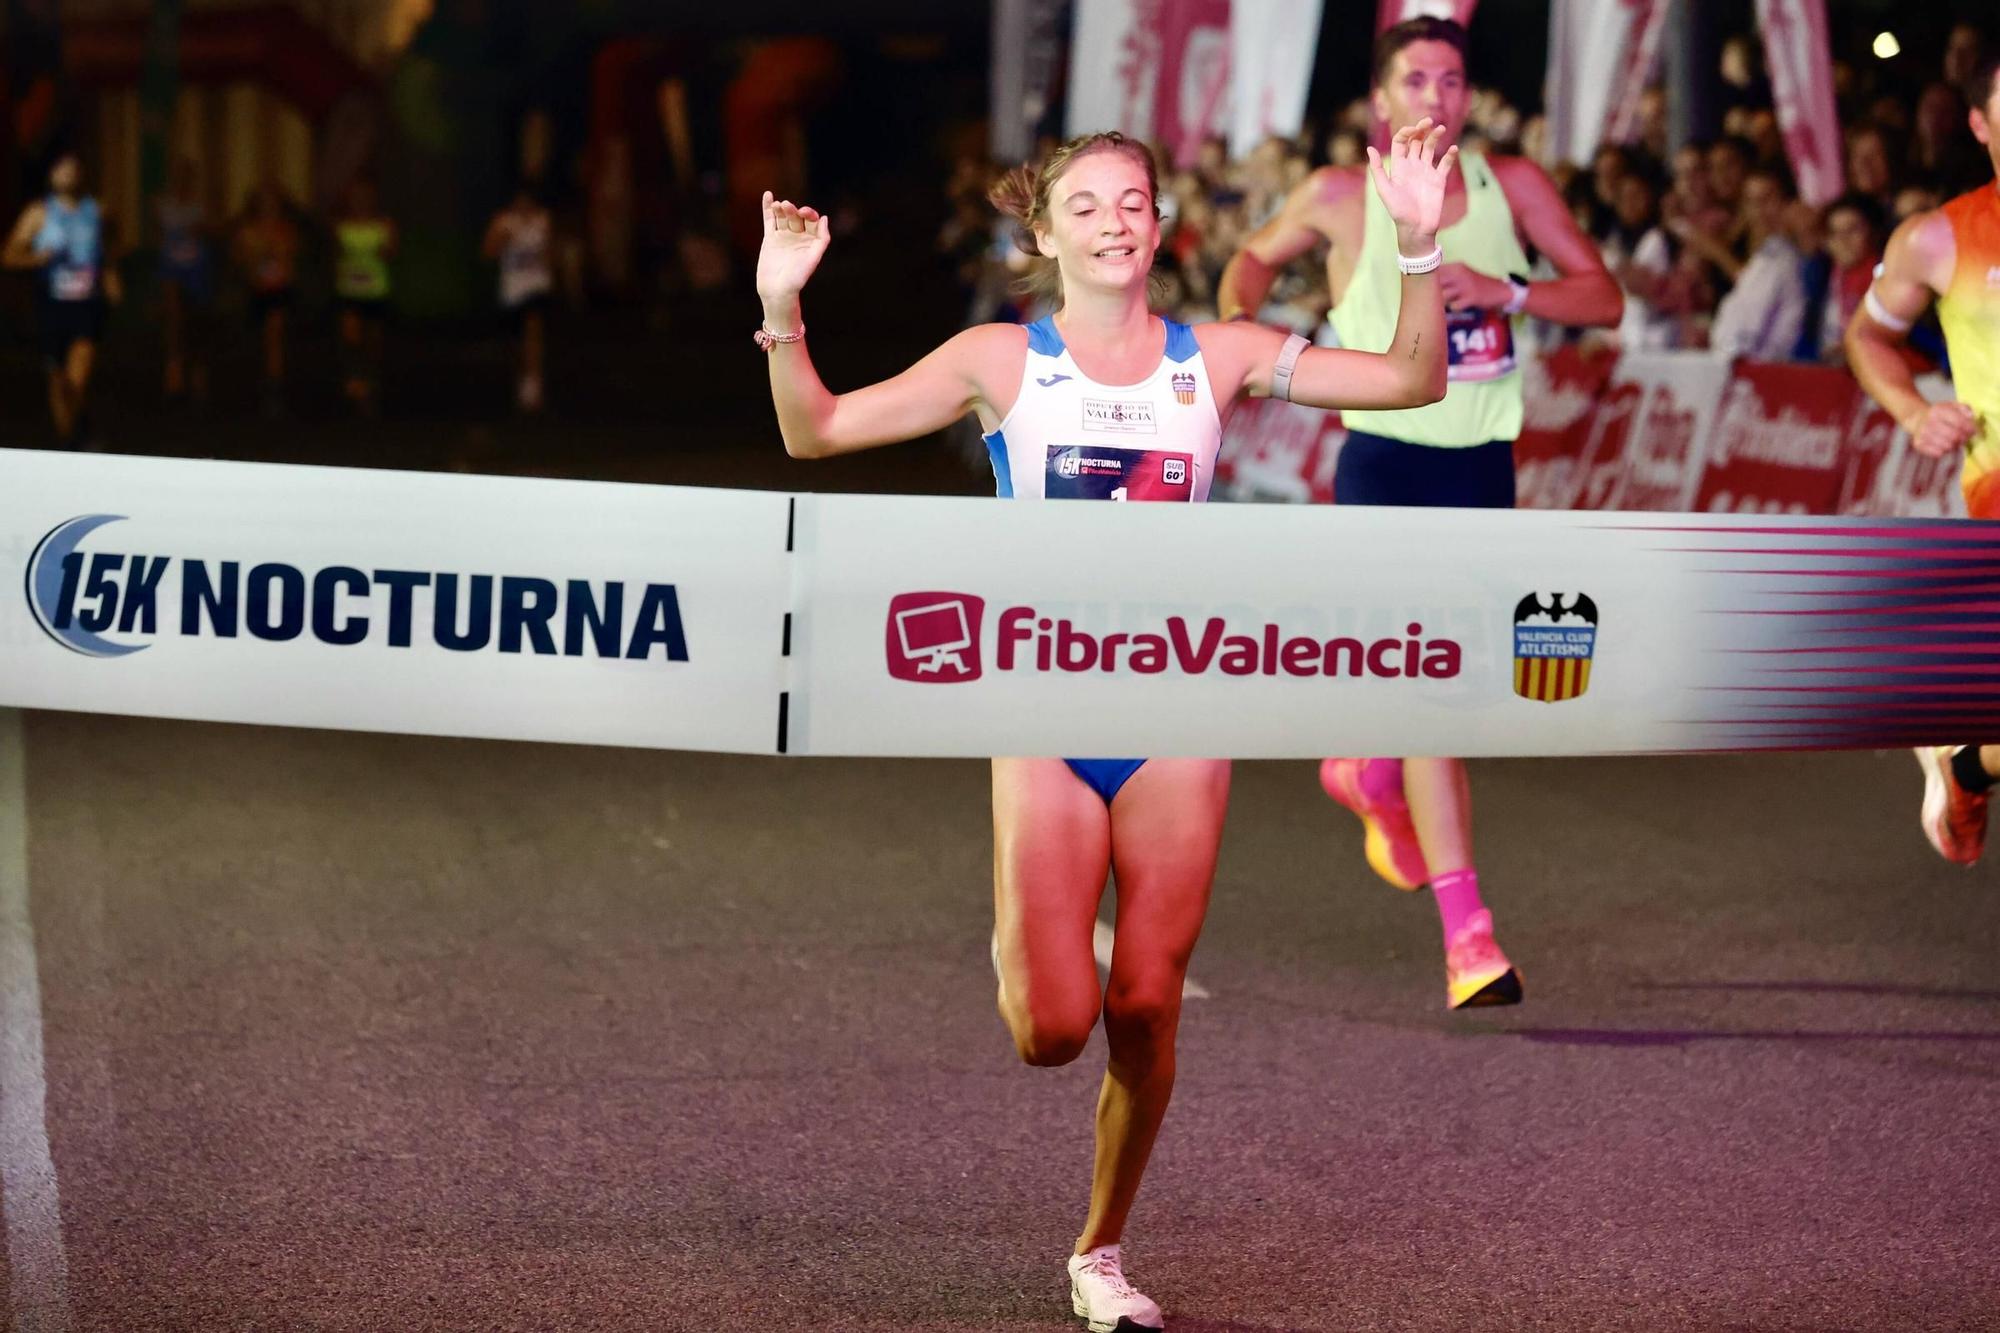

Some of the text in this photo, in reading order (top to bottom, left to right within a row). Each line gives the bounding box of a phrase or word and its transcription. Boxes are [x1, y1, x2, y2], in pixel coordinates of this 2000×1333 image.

[1451, 326, 1497, 354] 141
[1059, 456, 1082, 475] 15K
[1082, 458, 1122, 469] NOCTURNA
[1165, 461, 1184, 470] SUB
[53, 551, 690, 663] 15K NOCTURNA
[996, 606, 1463, 680] FibraValencia
[1517, 632, 1564, 643] VALENCIA
[1519, 643, 1589, 656] ATLETISMO
